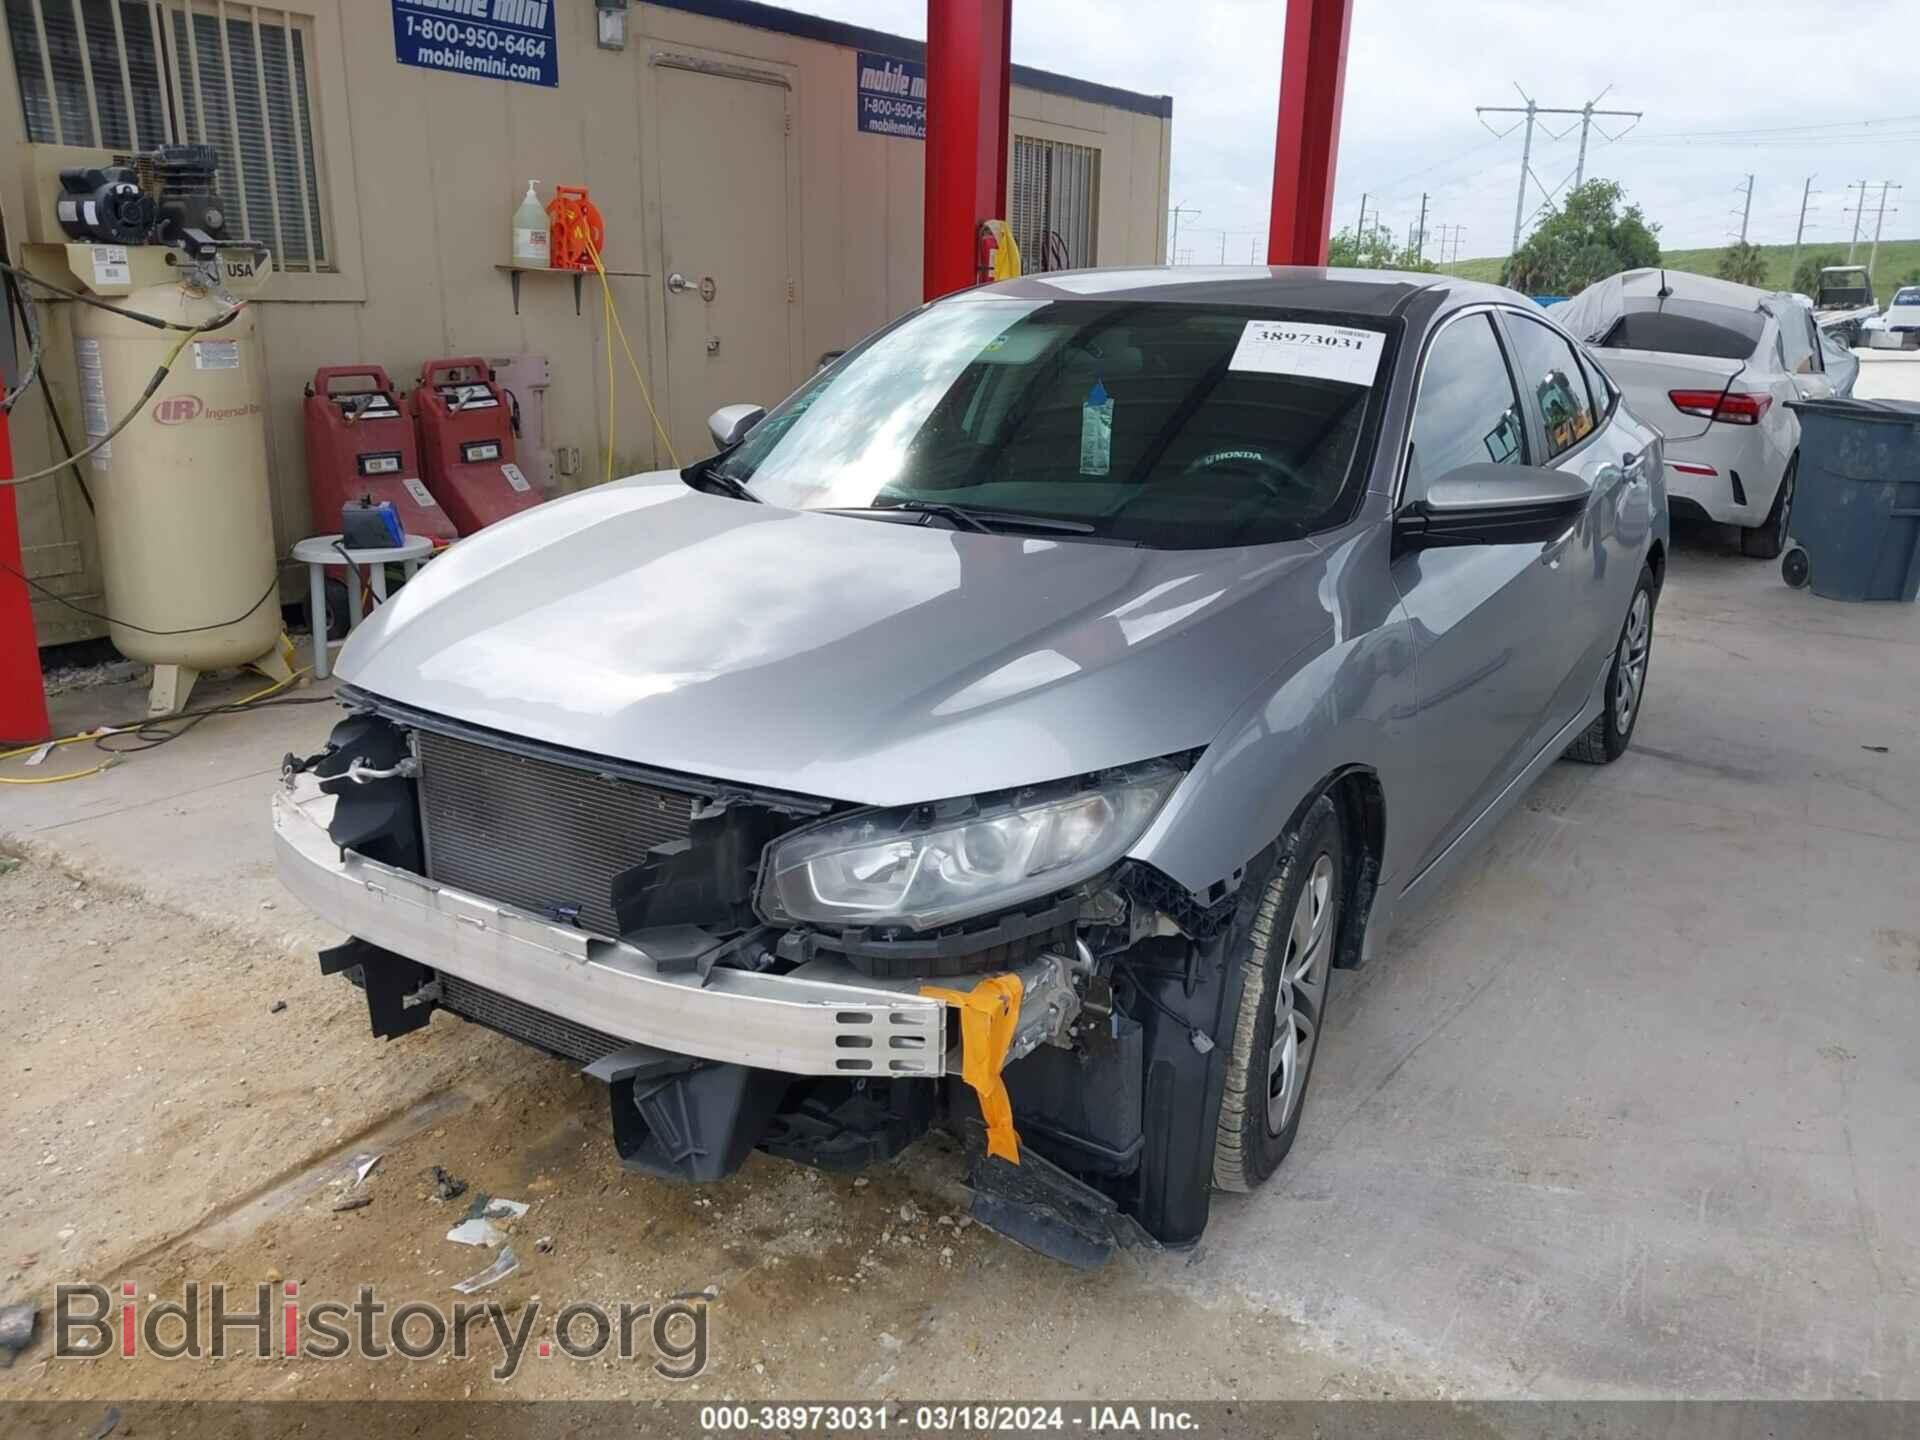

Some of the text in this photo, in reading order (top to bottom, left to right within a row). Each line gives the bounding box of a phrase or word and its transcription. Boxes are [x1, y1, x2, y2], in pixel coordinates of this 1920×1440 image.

[406, 16, 546, 59] 1-800-950-6464
[418, 47, 541, 81] mobilemini.com
[860, 61, 910, 96] mobile
[227, 264, 254, 278] USA
[1255, 330, 1363, 351] 38973031
[1215, 450, 1262, 461] HONDA
